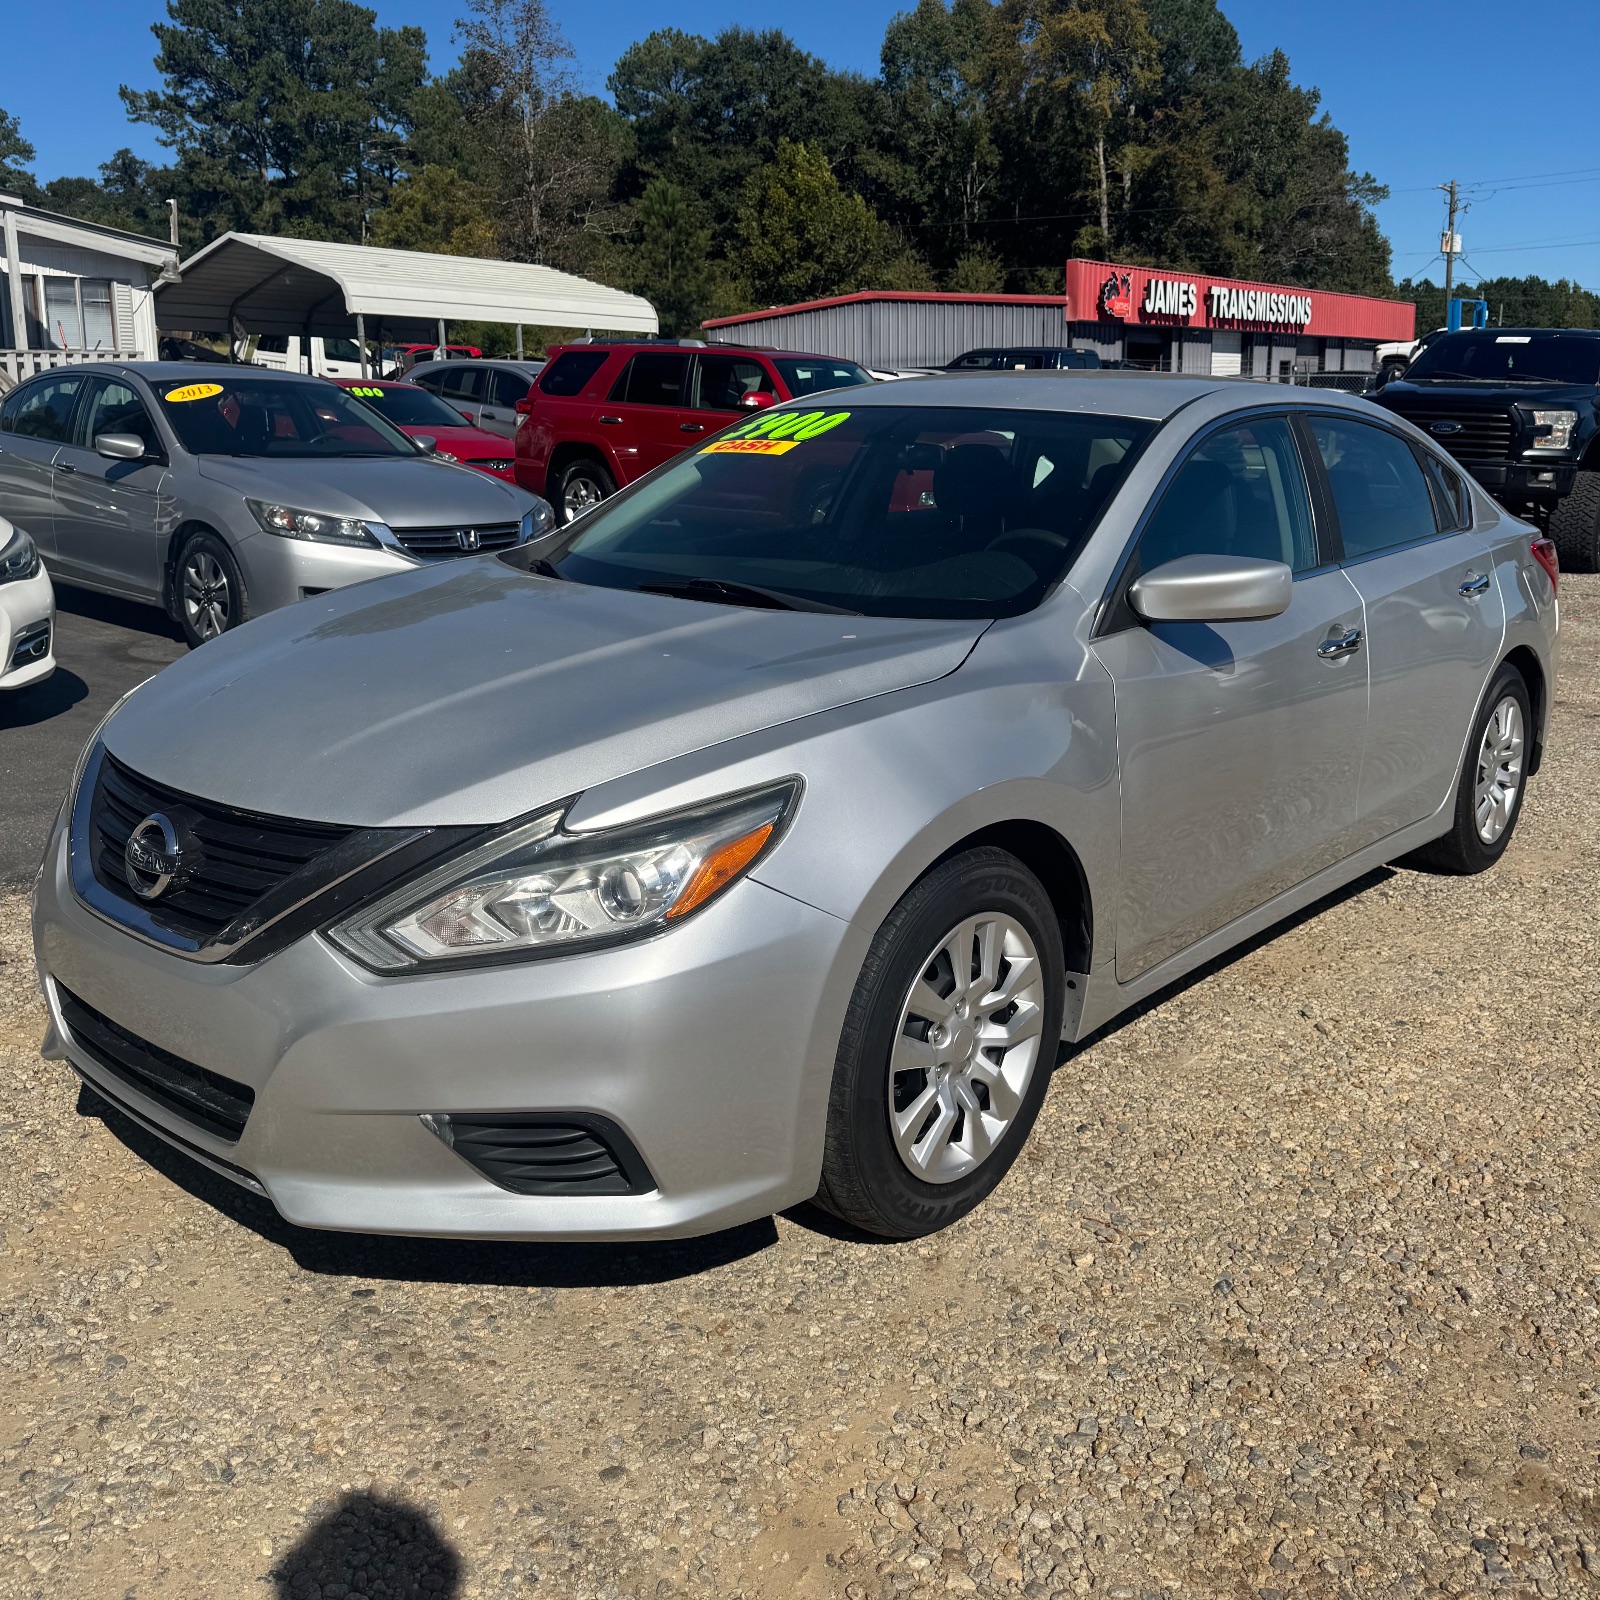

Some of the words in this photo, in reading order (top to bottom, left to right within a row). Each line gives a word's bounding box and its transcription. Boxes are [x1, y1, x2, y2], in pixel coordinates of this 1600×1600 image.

[1145, 279, 1197, 317] JAMES
[1210, 286, 1312, 325] TRANSMISSIONS
[178, 385, 213, 399] 2013
[345, 387, 384, 398] 800
[719, 411, 851, 441] 3900
[713, 440, 781, 453] CASH
